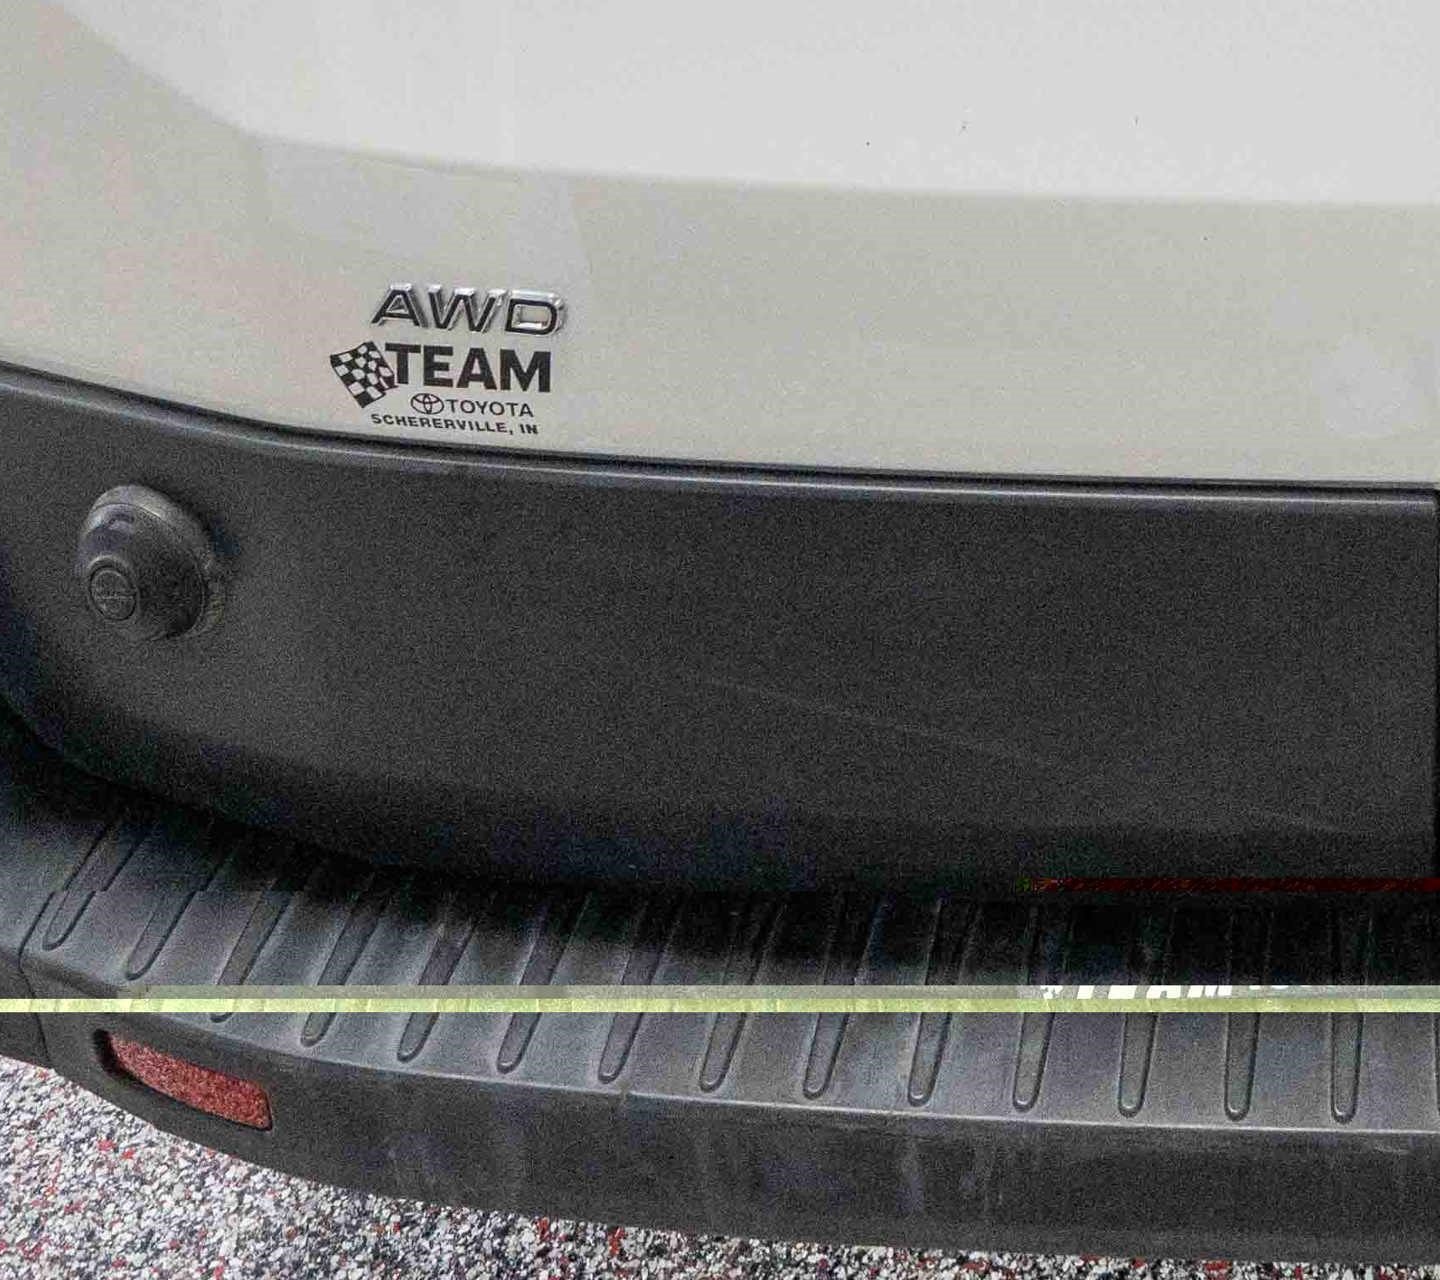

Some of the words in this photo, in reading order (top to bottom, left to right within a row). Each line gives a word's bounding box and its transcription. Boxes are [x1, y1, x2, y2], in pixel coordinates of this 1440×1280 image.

[371, 282, 565, 336] AWD
[384, 342, 551, 393] TEAM
[370, 414, 513, 435] SCHERERVILLE,
[519, 423, 539, 436] IN
[444, 398, 535, 418] TOYOTA
